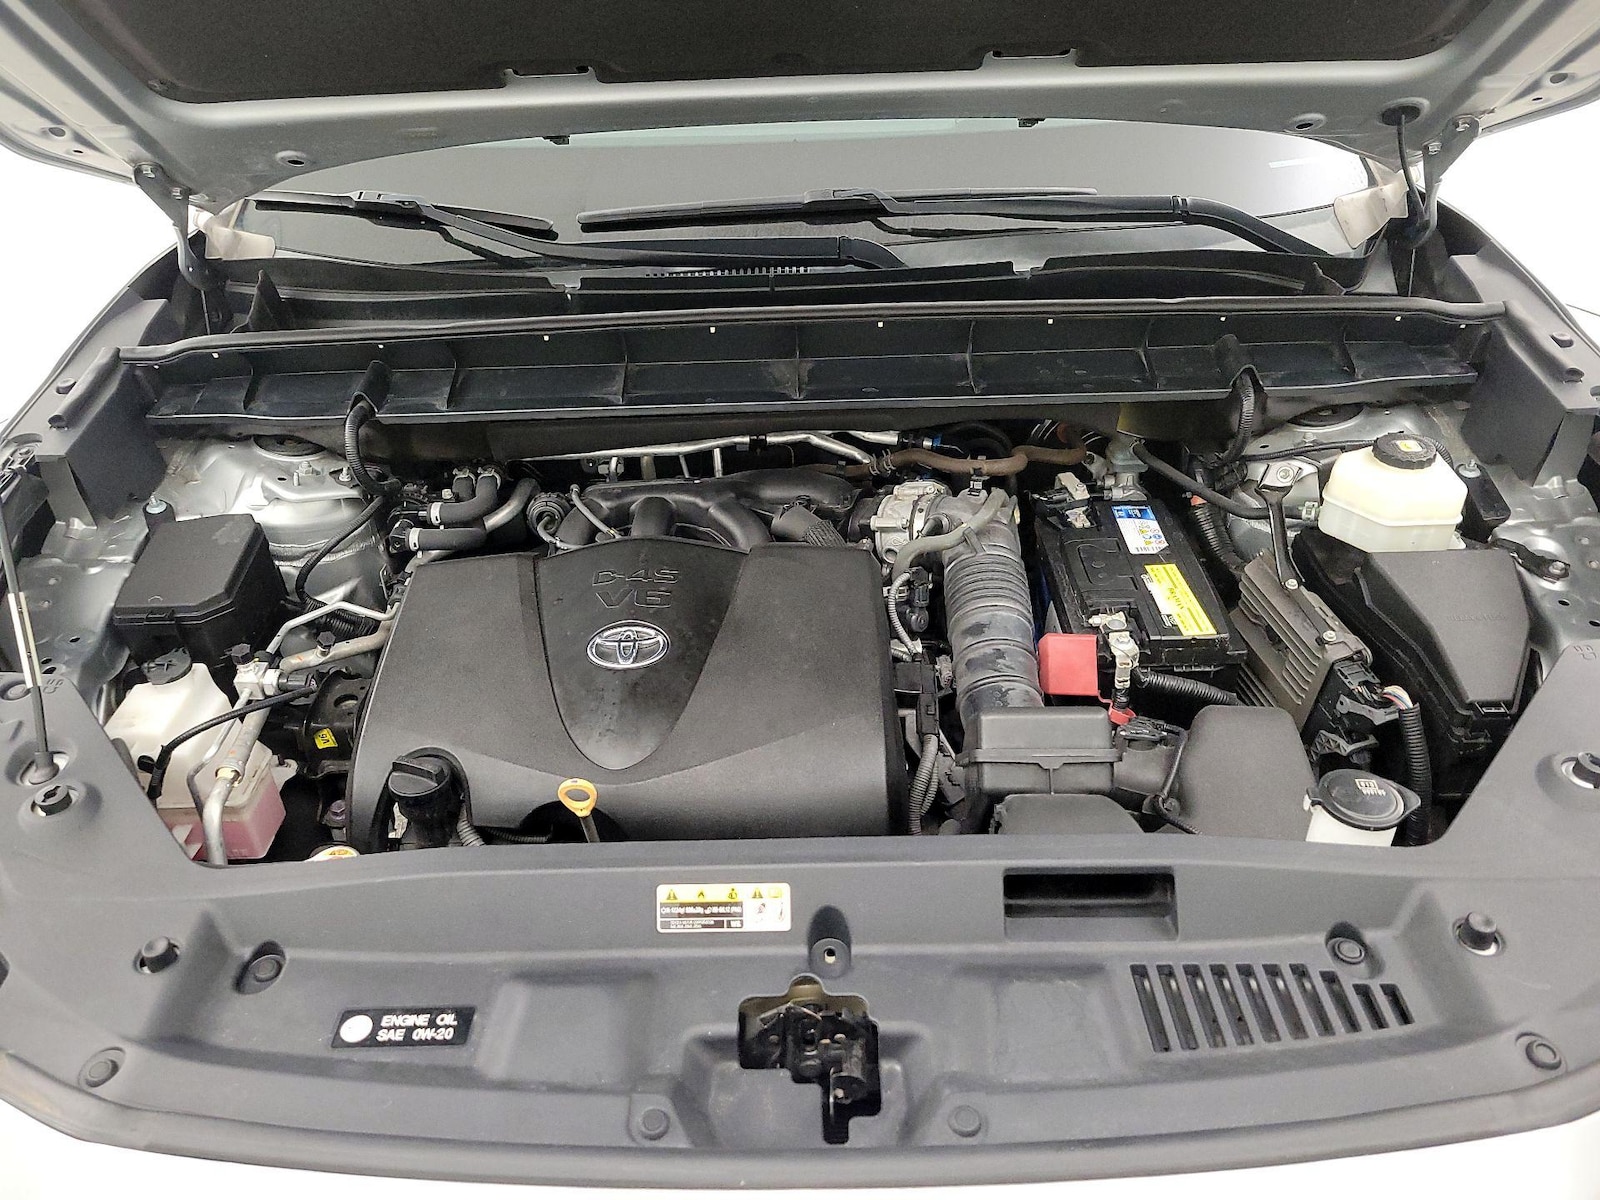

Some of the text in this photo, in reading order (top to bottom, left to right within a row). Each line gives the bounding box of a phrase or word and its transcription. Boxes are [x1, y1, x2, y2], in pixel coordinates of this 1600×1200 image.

[592, 569, 679, 586] D-4S
[595, 588, 672, 608] V6
[380, 1013, 458, 1026] ENGINE OIL
[376, 1027, 454, 1041] SAE 0W-20
